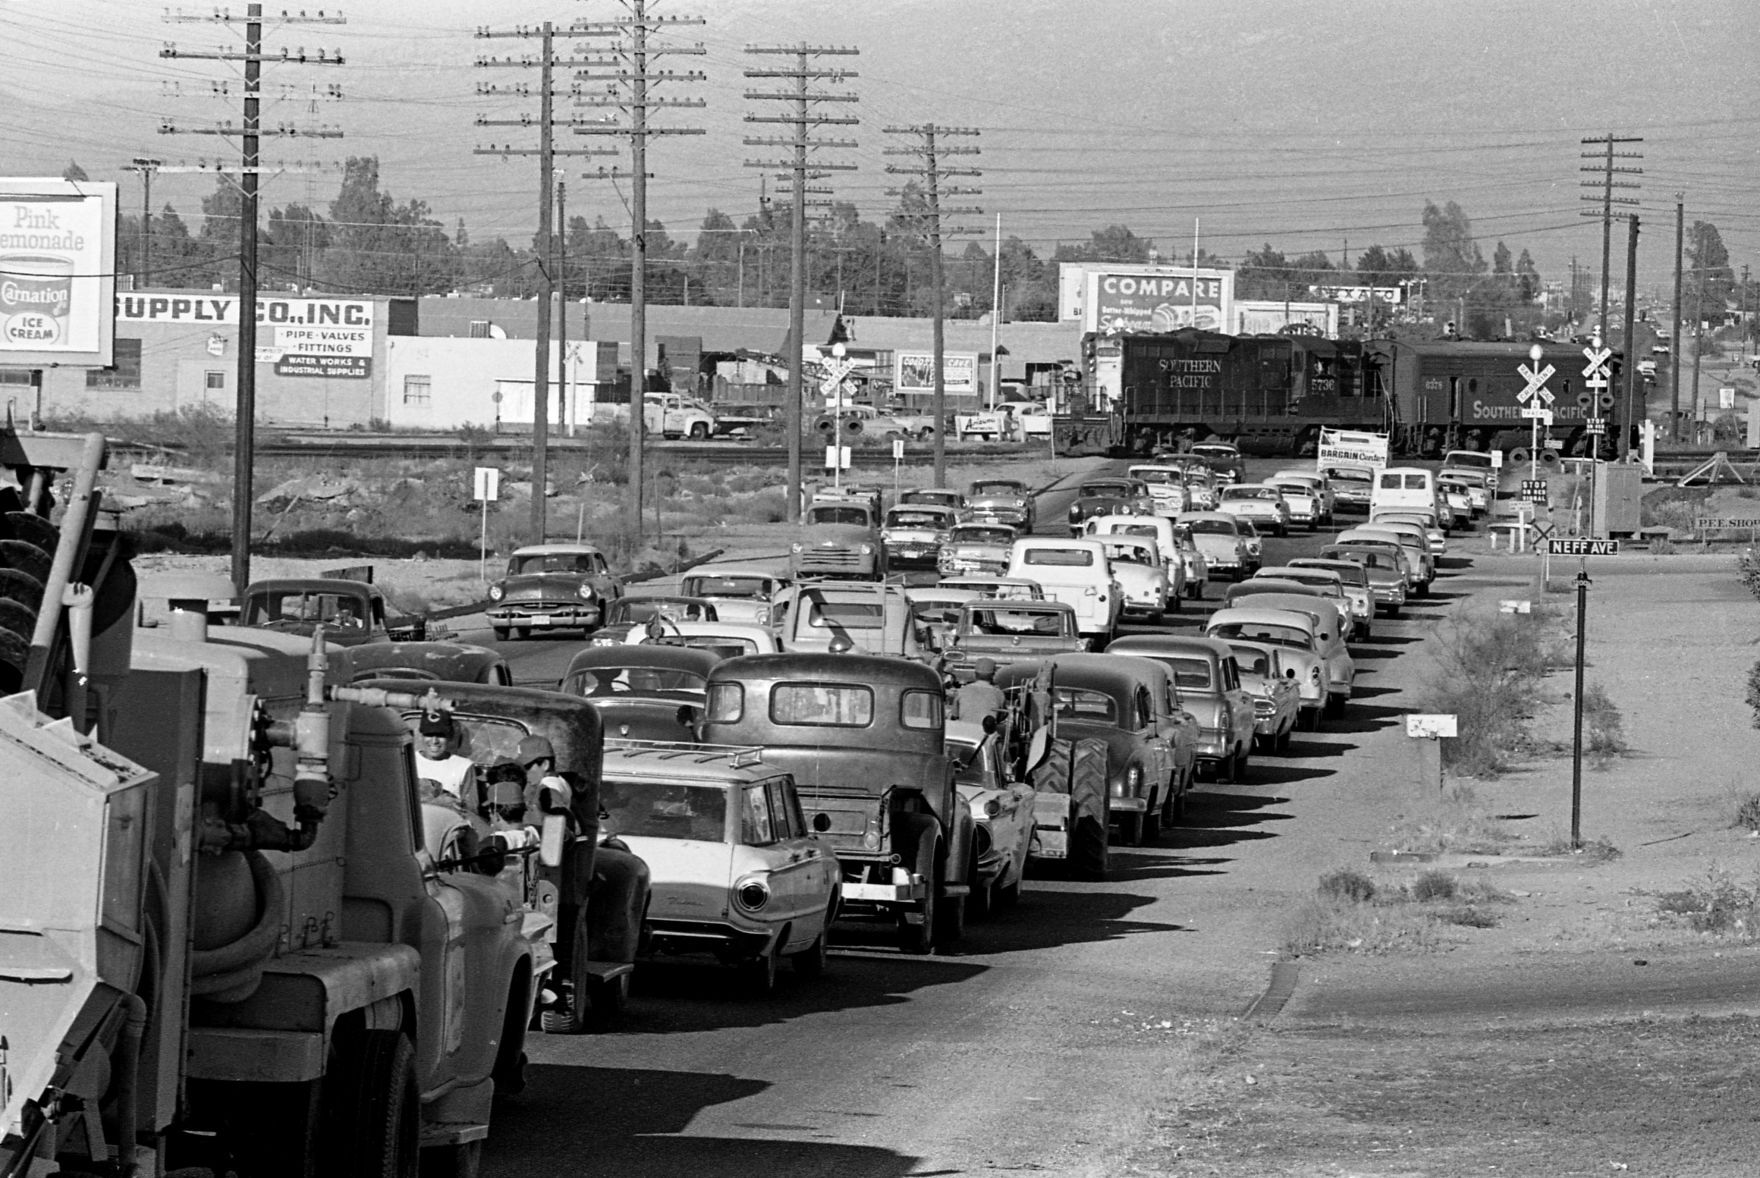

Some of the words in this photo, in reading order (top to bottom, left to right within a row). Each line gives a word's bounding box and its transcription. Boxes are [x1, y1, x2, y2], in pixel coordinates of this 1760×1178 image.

[14, 206, 60, 229] Pink
[0, 231, 84, 251] emonade
[2, 281, 68, 305] Carnation
[1104, 278, 1220, 298] COMPARE
[307, 303, 371, 325] INC.
[22, 317, 43, 328] ICE
[10, 328, 53, 339] CREAM
[286, 331, 313, 339] PIPE
[321, 332, 365, 341] VALVES
[298, 343, 352, 352] FITTINGS
[288, 357, 317, 365] WATER
[320, 358, 352, 366] WORKS
[358, 359, 366, 367] &
[280, 366, 324, 374] INDUSTRIAL
[327, 367, 366, 376] SUPPLIES
[1170, 375, 1211, 388] PACIFIC
[1473, 401, 1523, 418] SOUTHE
[1321, 449, 1359, 460] BARGAIN
[1522, 481, 1546, 489] STOP
[1552, 541, 1588, 554] NEFF
[1590, 542, 1618, 555] AVE.
